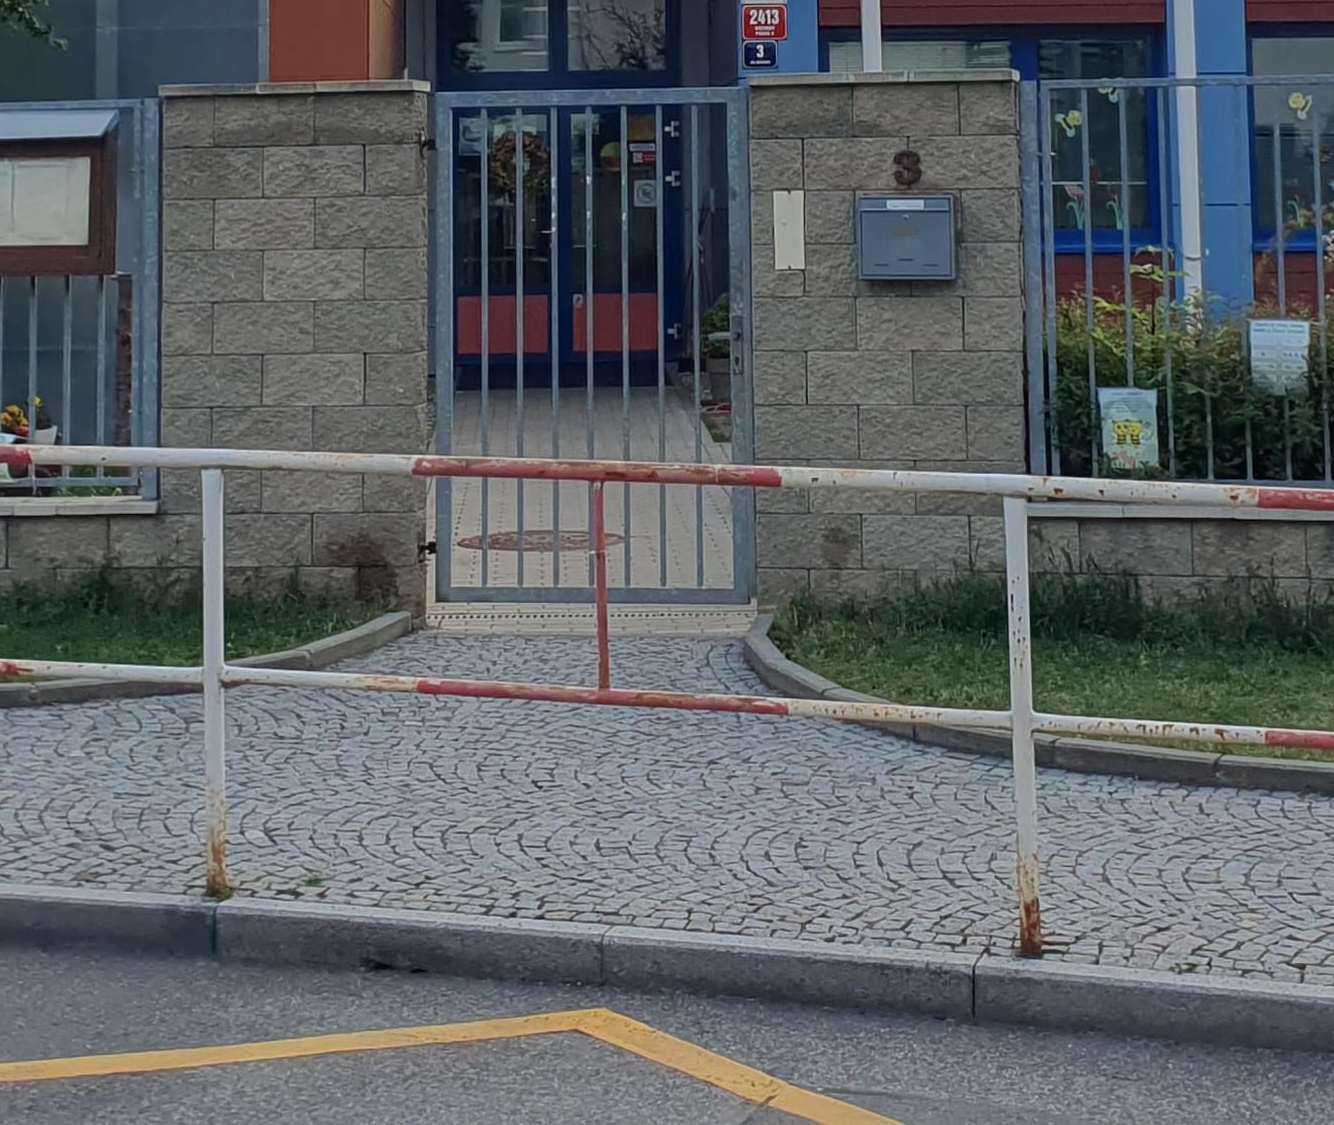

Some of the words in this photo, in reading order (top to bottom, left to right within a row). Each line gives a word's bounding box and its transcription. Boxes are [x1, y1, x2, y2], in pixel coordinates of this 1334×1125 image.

[749, 9, 780, 25] 2413
[756, 44, 764, 58] 3
[893, 150, 923, 185] 3
